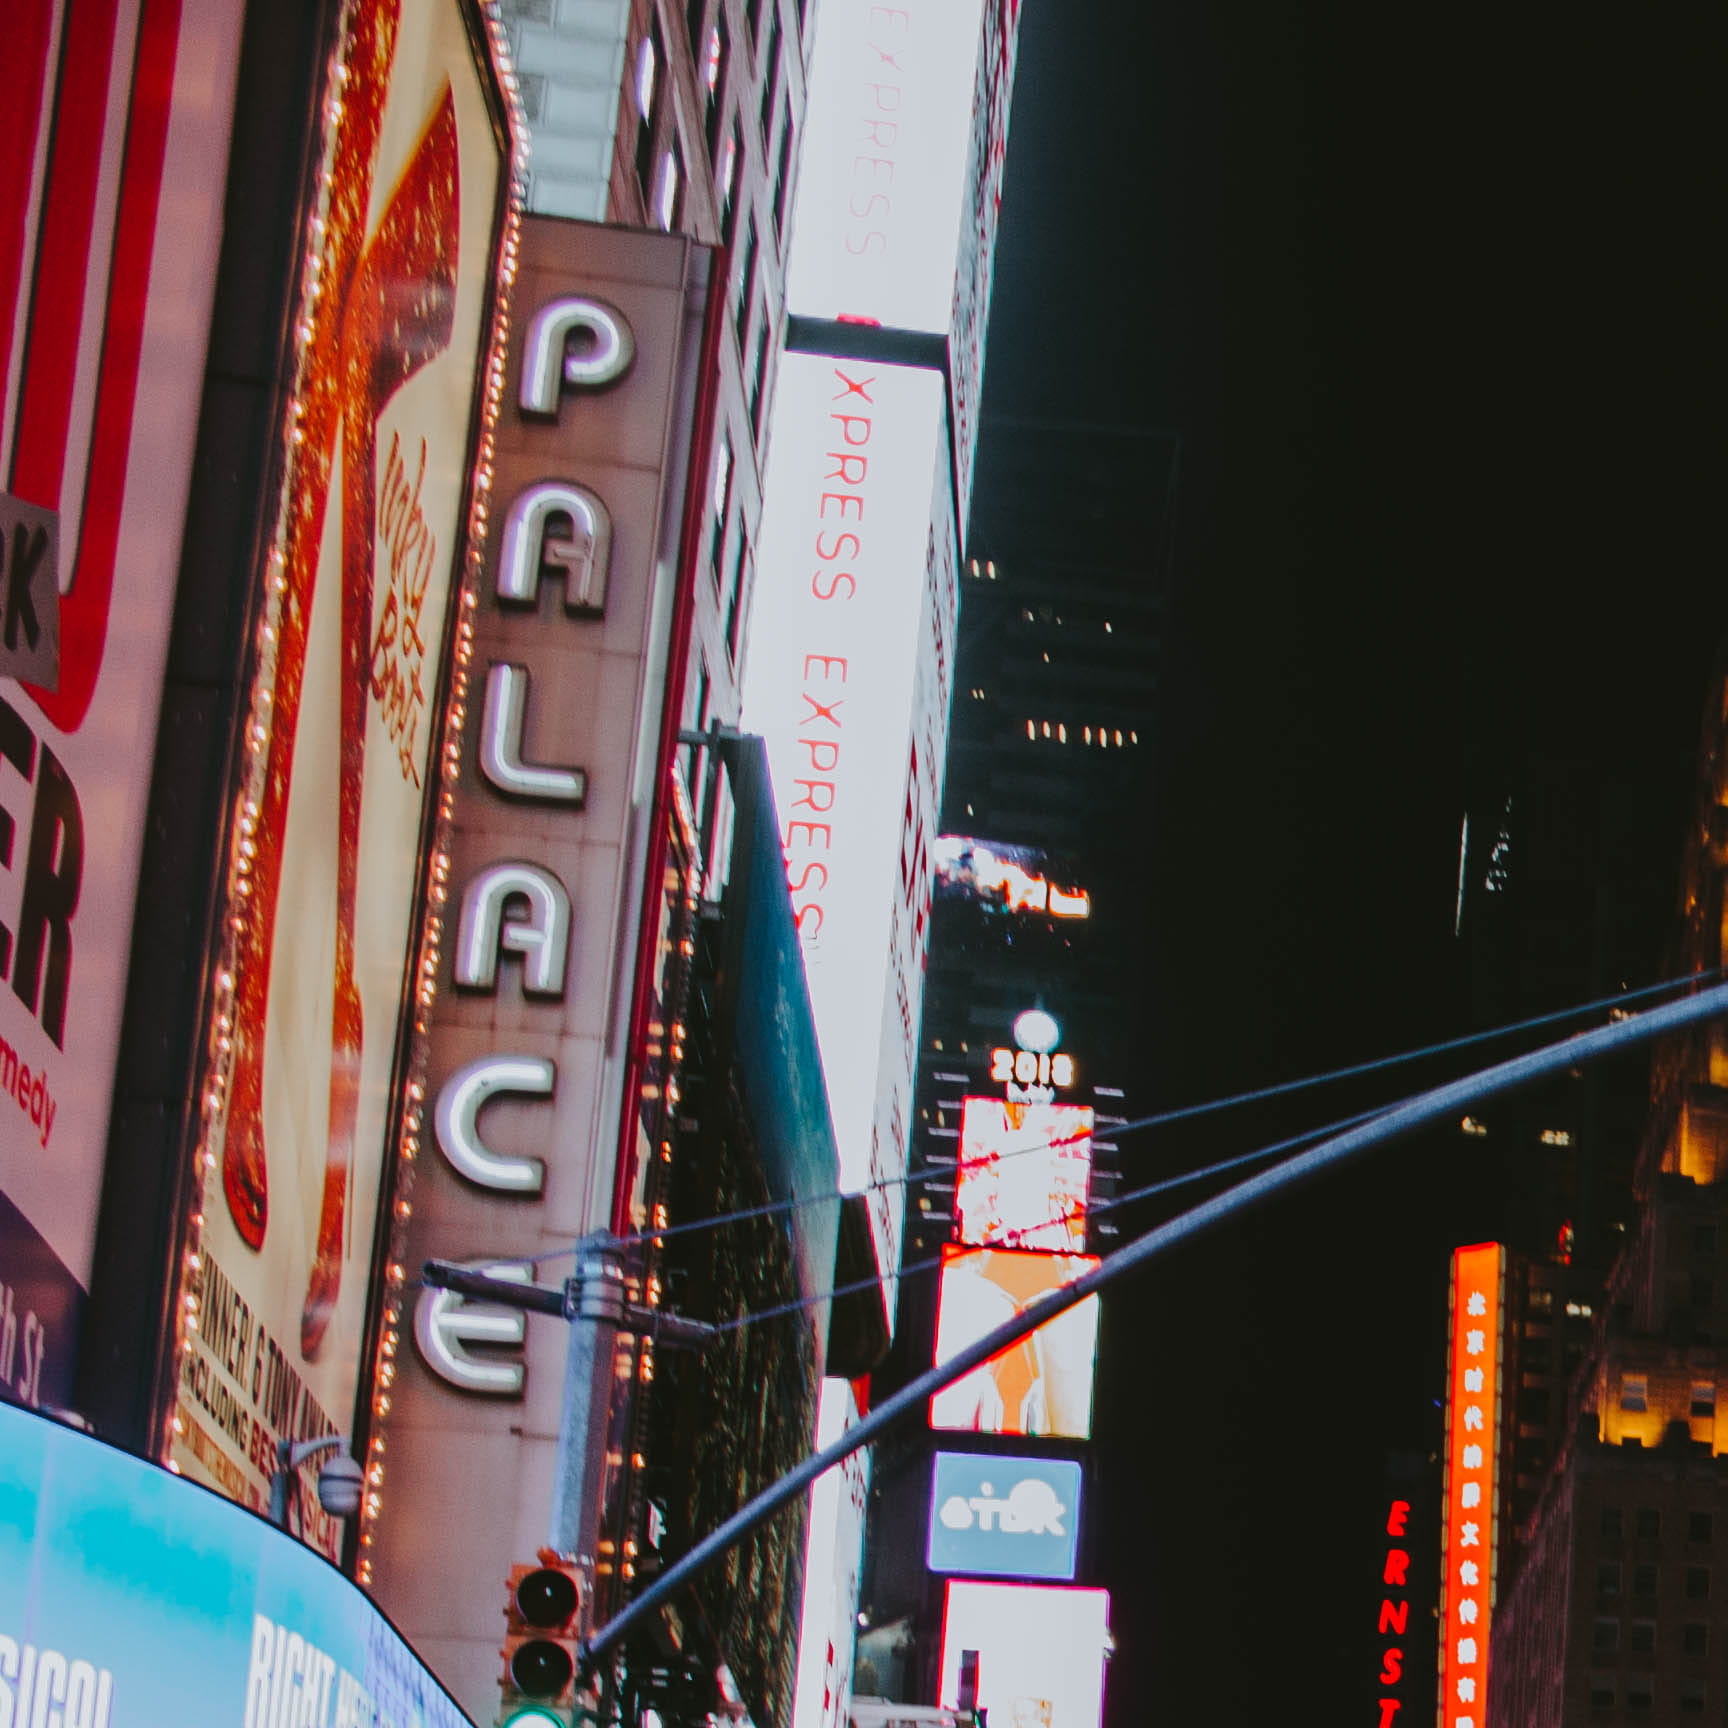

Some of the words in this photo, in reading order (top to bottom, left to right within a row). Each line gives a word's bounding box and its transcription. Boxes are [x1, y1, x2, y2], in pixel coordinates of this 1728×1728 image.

[845, 7, 910, 257] EXPRESS
[812, 368, 875, 601] XPRESS
[415, 297, 636, 1395] PALACE
[0, 1036, 57, 1150] medy
[991, 1048, 1074, 1087] 2018
[253, 1322, 266, 1407] 6
[250, 1413, 280, 1480] BES
